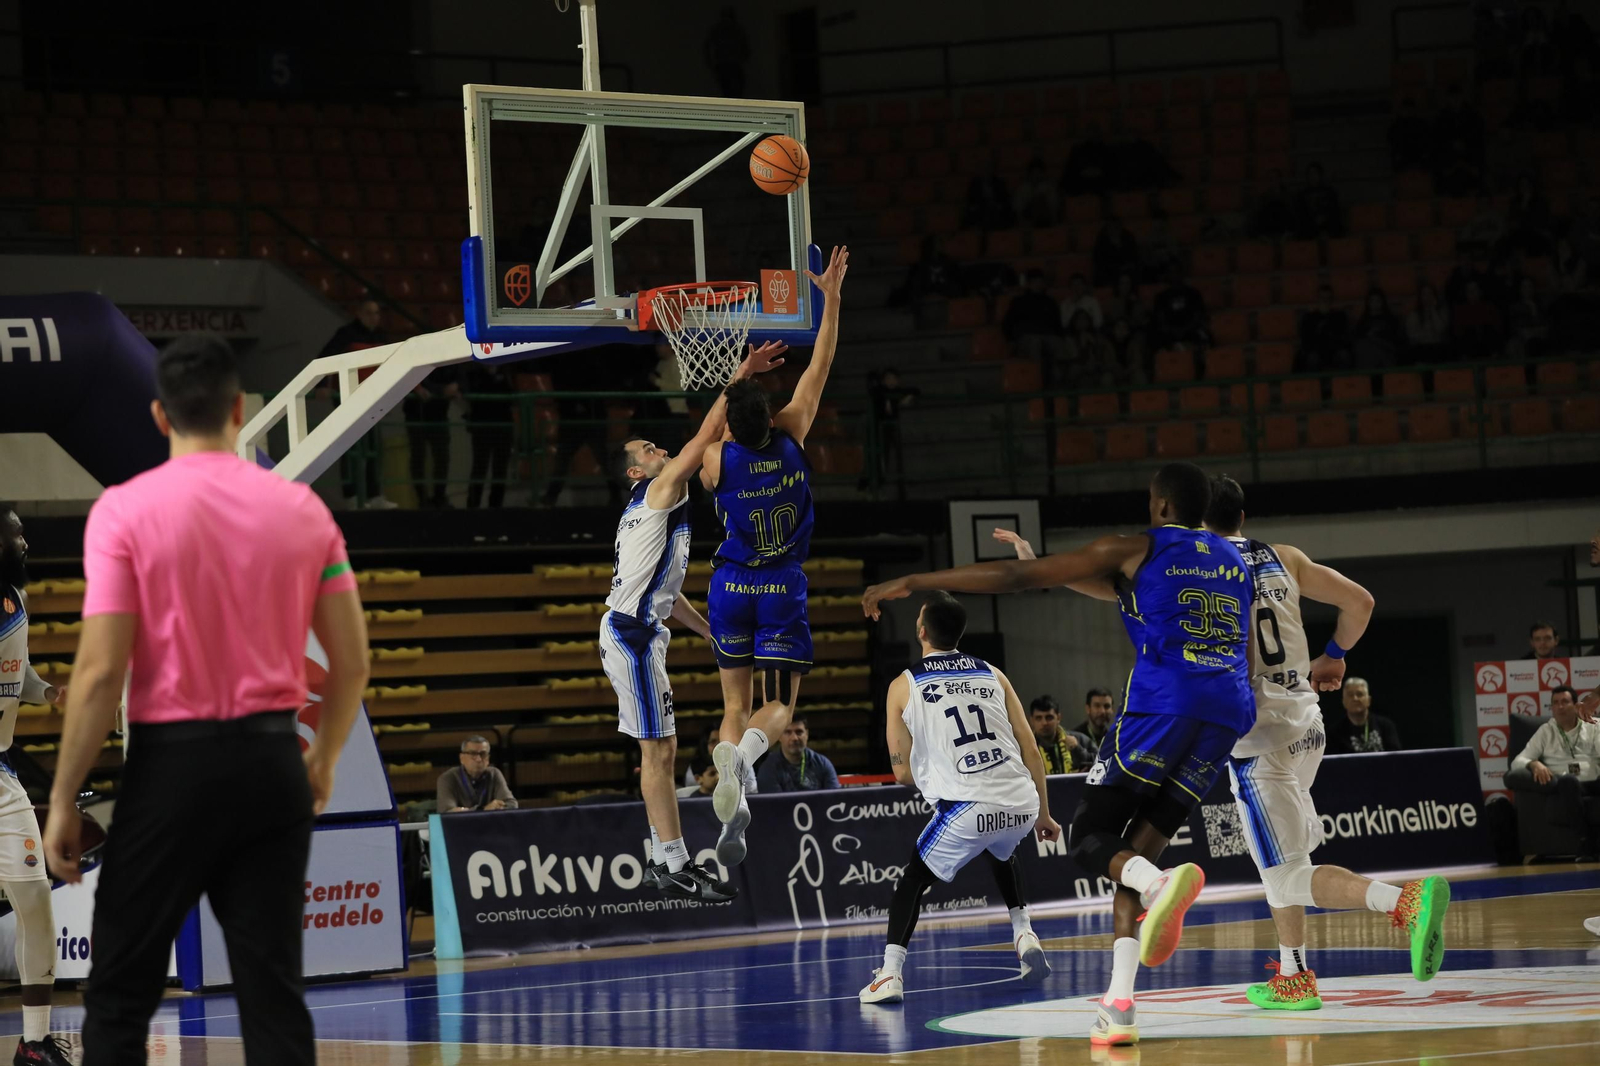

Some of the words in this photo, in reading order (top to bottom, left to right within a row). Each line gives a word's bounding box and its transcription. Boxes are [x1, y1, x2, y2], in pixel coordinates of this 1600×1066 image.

[271, 53, 291, 86] 5
[737, 483, 782, 499] cloud.gal
[749, 503, 797, 555] 10
[1165, 565, 1218, 580] cloud.gal
[1178, 588, 1241, 642] 35
[924, 656, 977, 671] MANCHÓN
[946, 687, 995, 698] energy
[944, 704, 996, 747] 11
[476, 902, 583, 923] construcción
[589, 903, 597, 917] y
[601, 896, 732, 915] mantenimie
[926, 902, 941, 914] que
